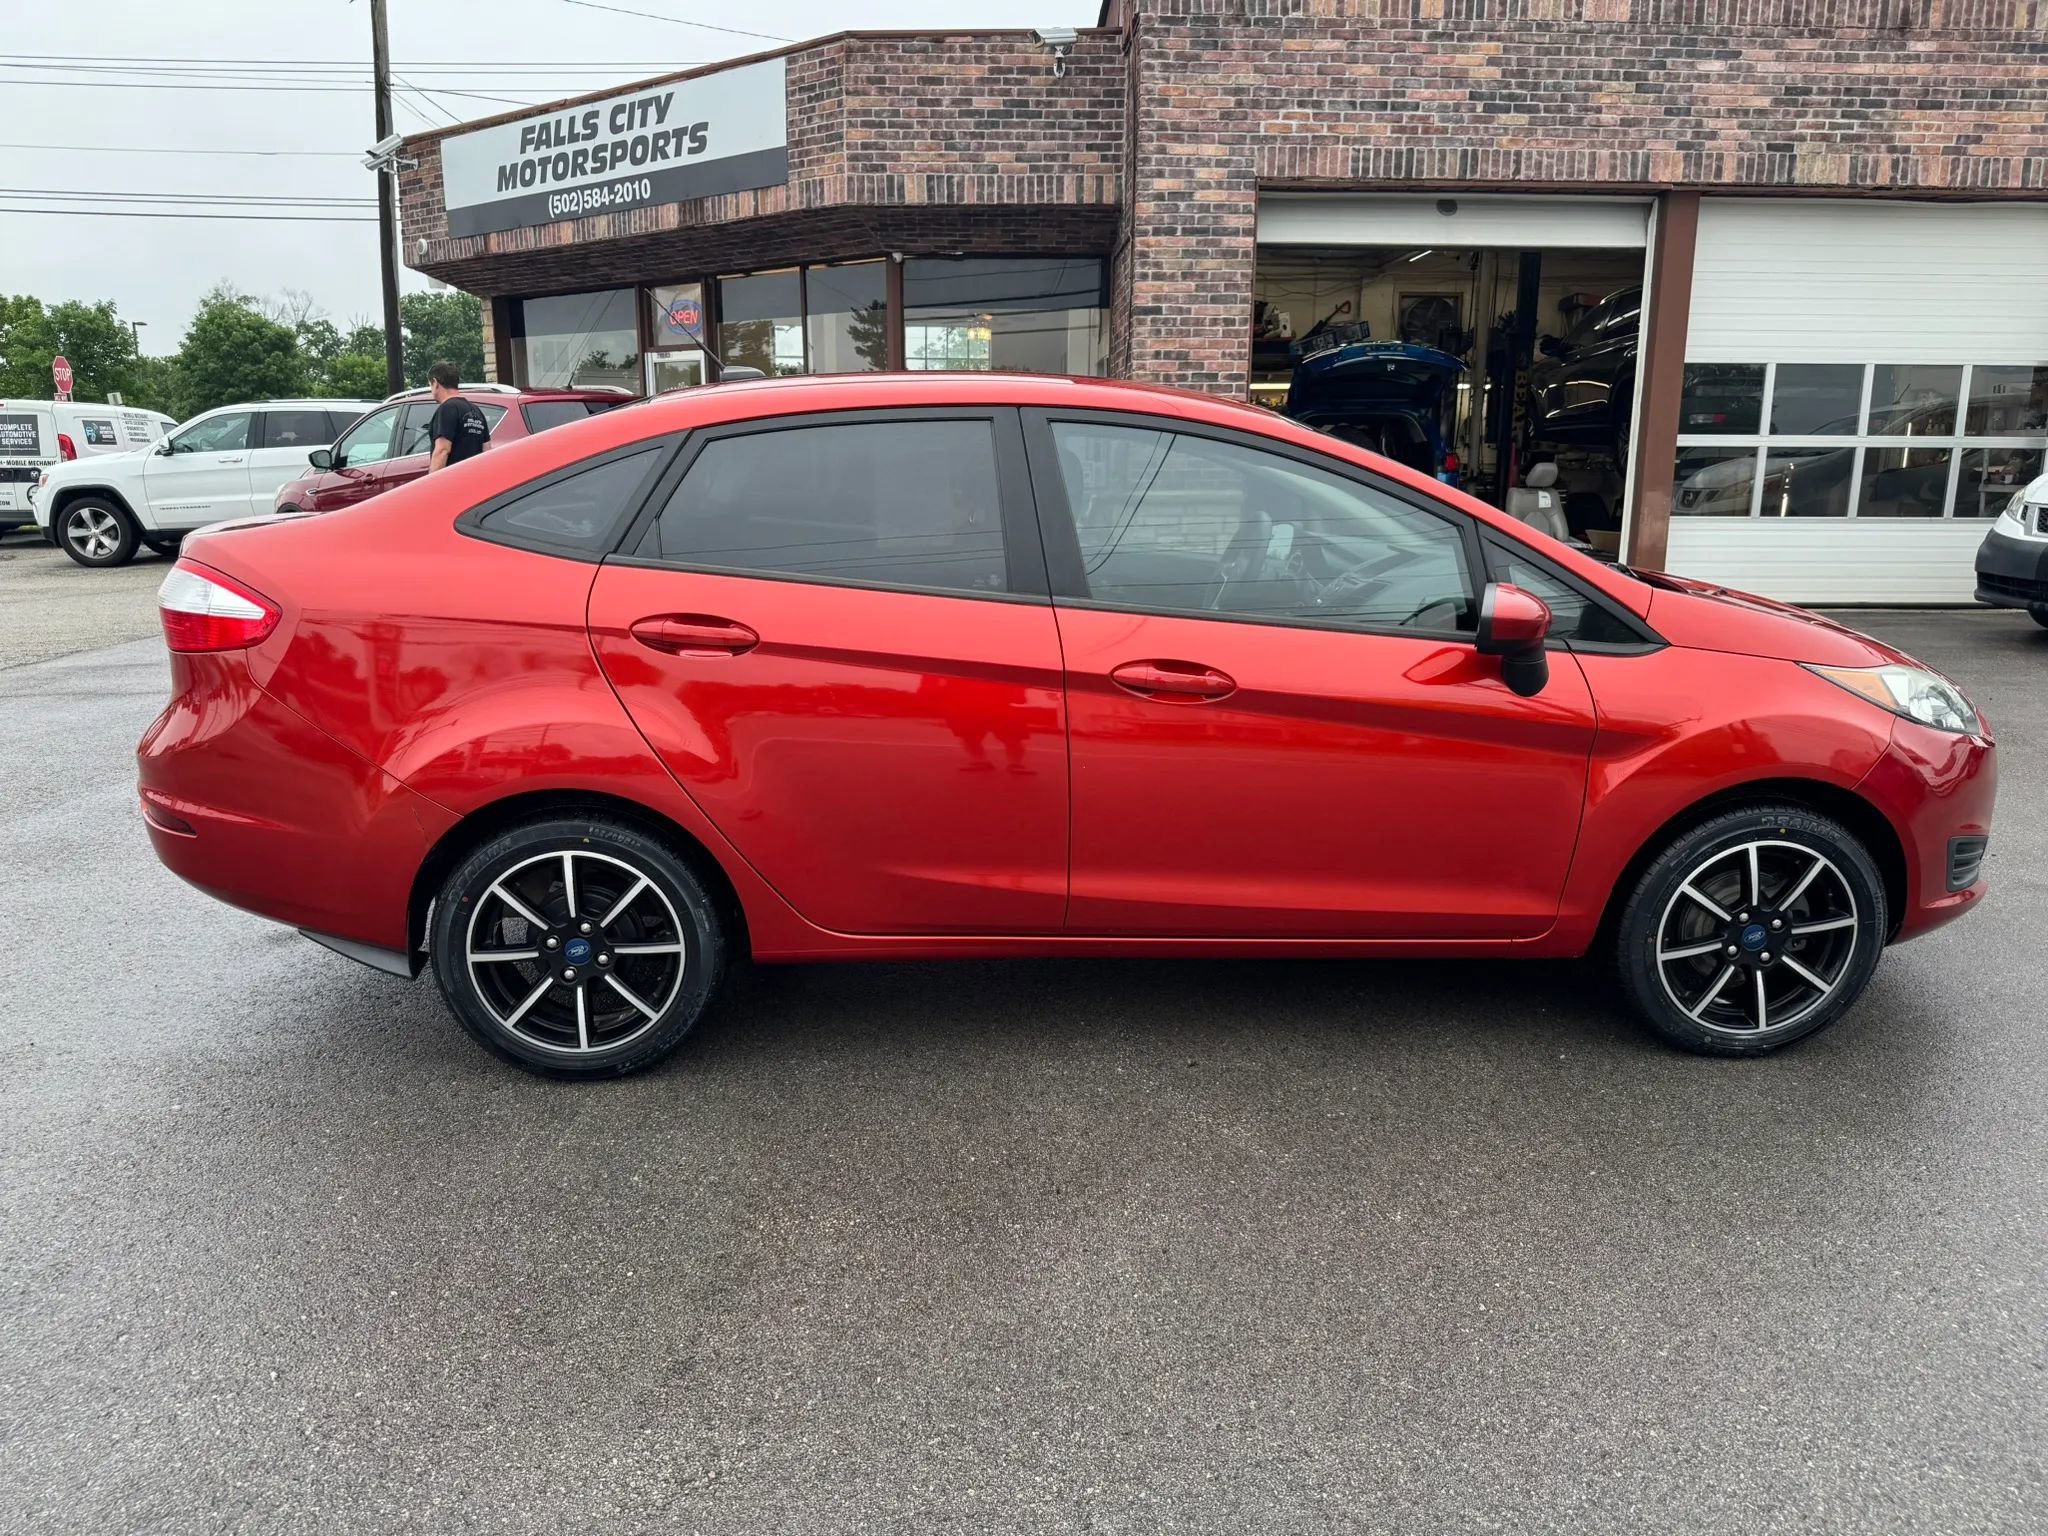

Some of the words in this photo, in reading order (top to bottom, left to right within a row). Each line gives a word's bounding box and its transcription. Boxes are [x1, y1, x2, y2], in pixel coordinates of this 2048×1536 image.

[520, 109, 600, 155] FALLS
[609, 91, 675, 135] CITY
[497, 121, 710, 193] MOTORSPORTS
[548, 177, 652, 219] (502)584-2010
[670, 310, 698, 325] OPEN
[54, 367, 71, 382] STOP
[0, 430, 37, 439] UTOMOTIVE
[1, 438, 33, 446] SERVICES
[7, 459, 26, 467] MOBILE
